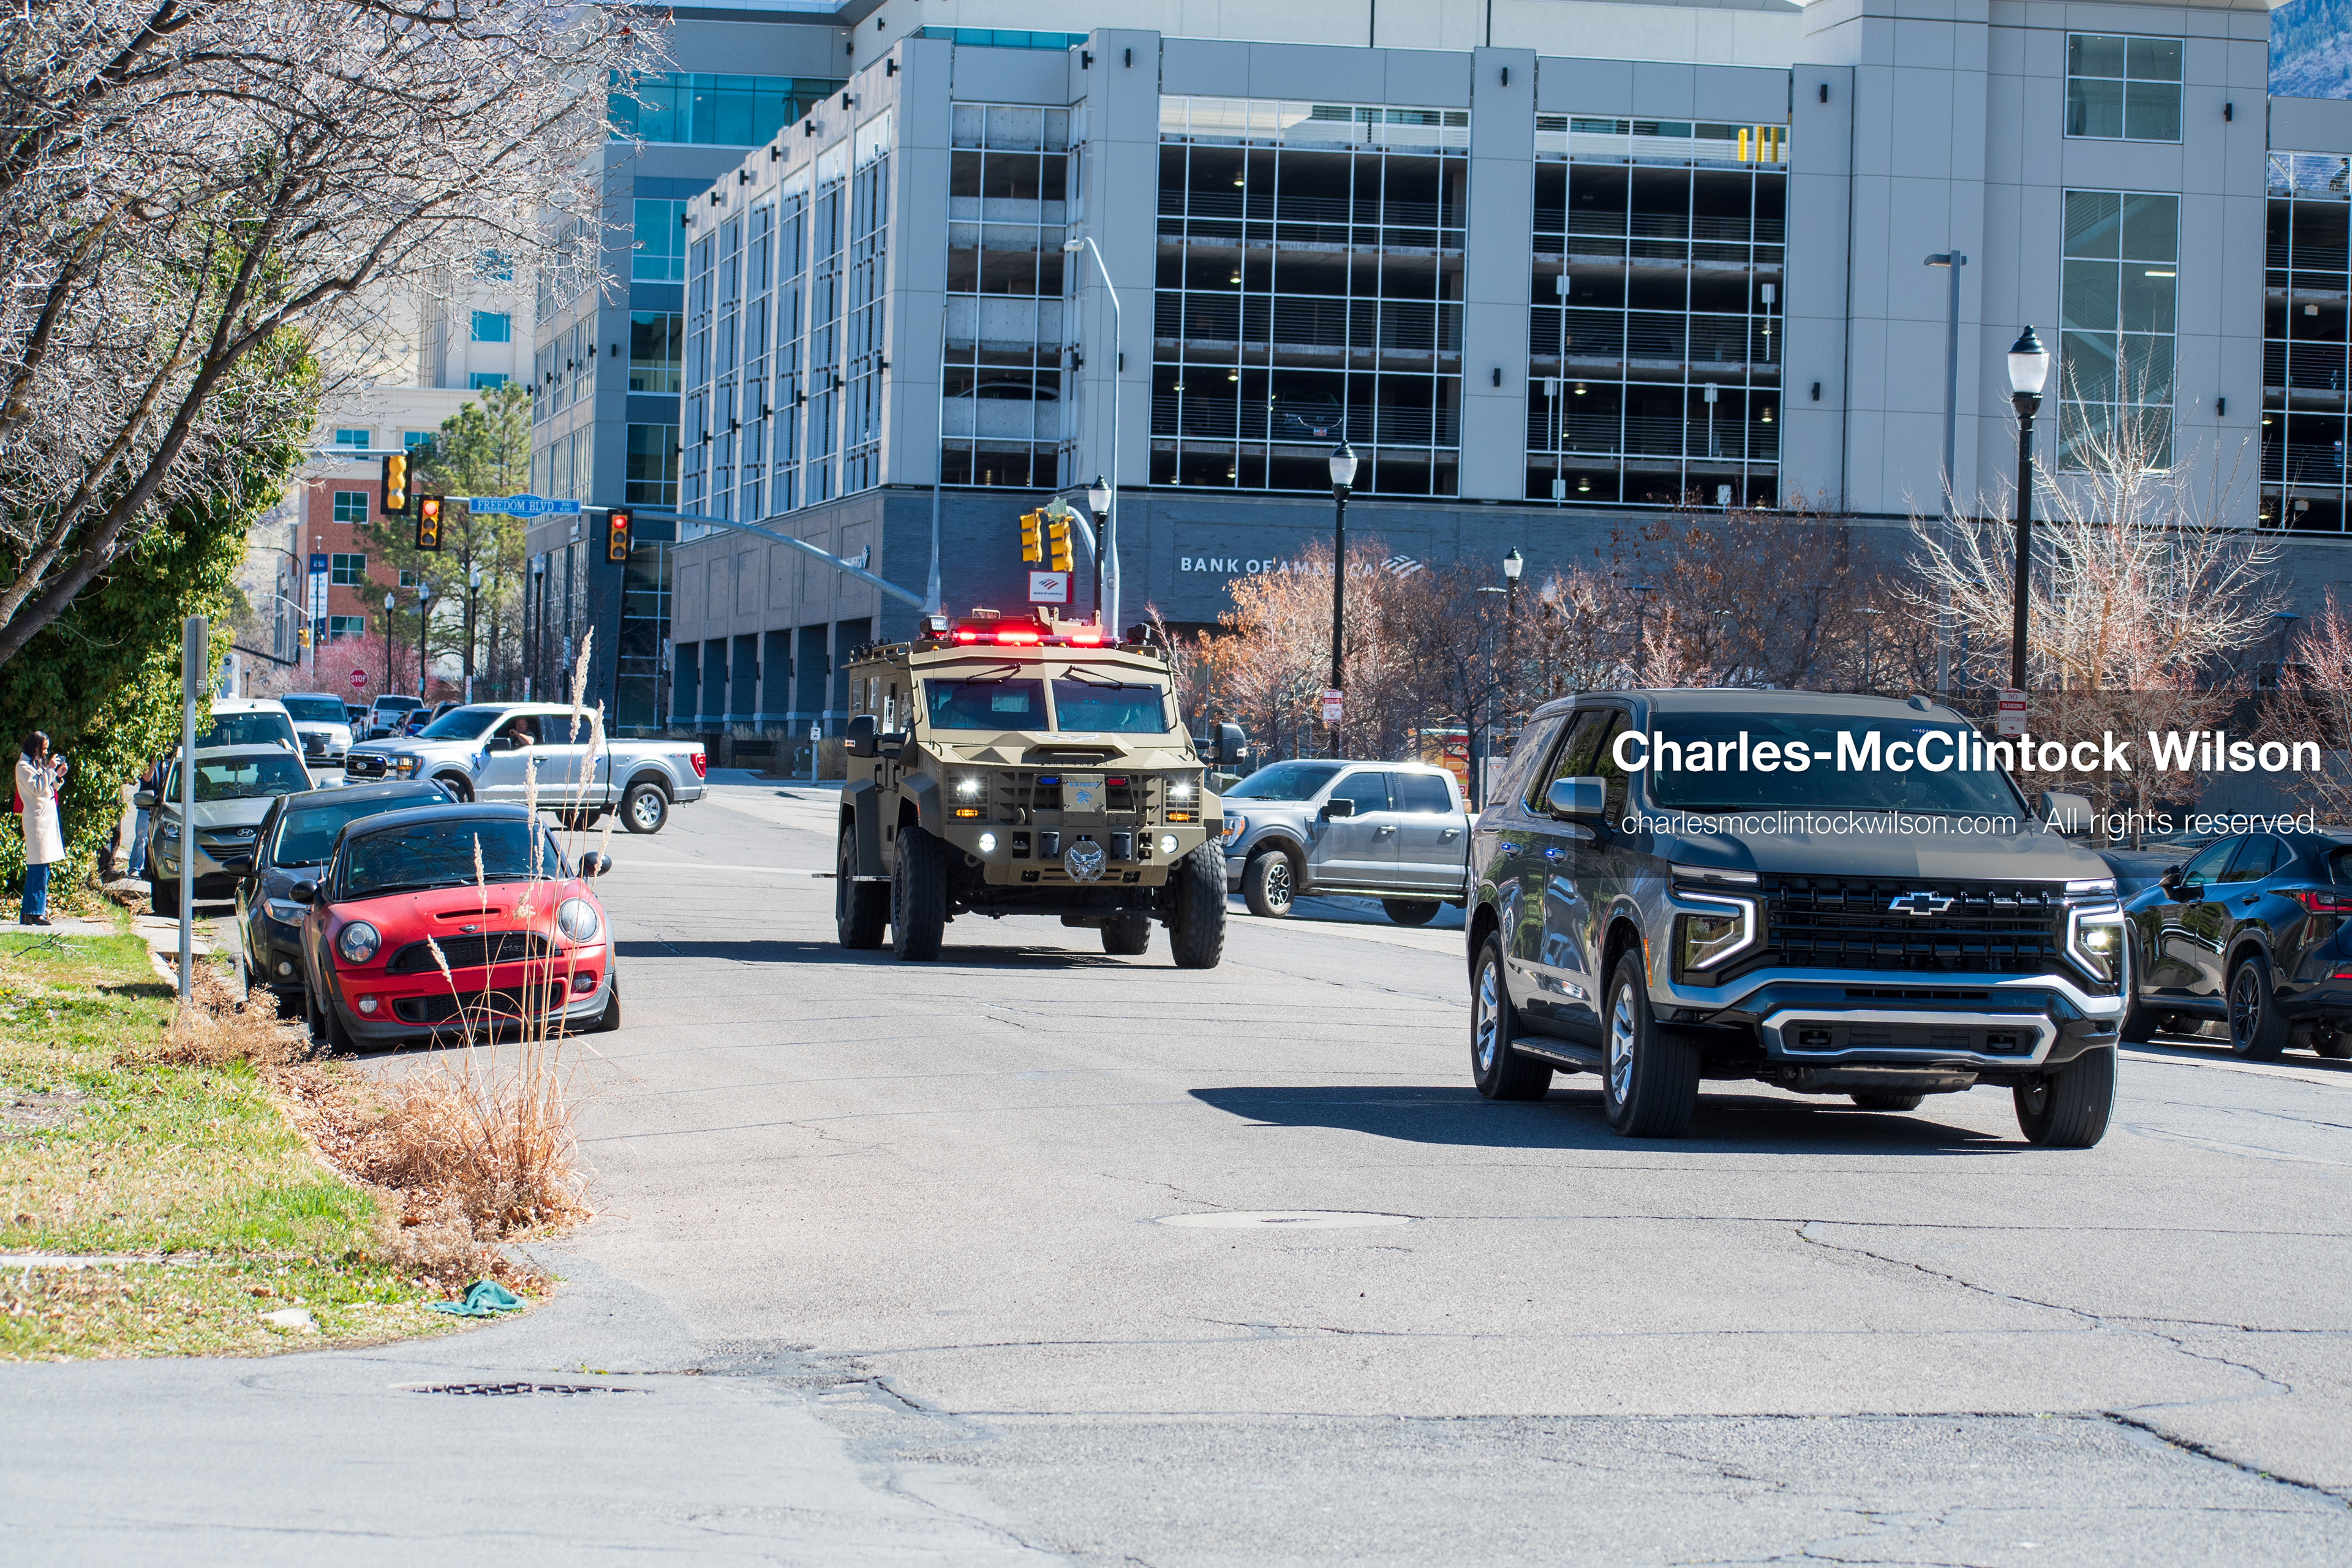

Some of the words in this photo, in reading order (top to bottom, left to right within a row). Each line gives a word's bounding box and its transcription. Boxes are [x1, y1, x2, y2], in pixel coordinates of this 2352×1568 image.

[477, 500, 526, 511] FREEDOM
[529, 501, 554, 511] BLVD
[1180, 557, 1239, 573] BANK
[1245, 559, 1272, 574] OF
[1277, 560, 1374, 578] AMERCA
[350, 674, 367, 683] STOP
